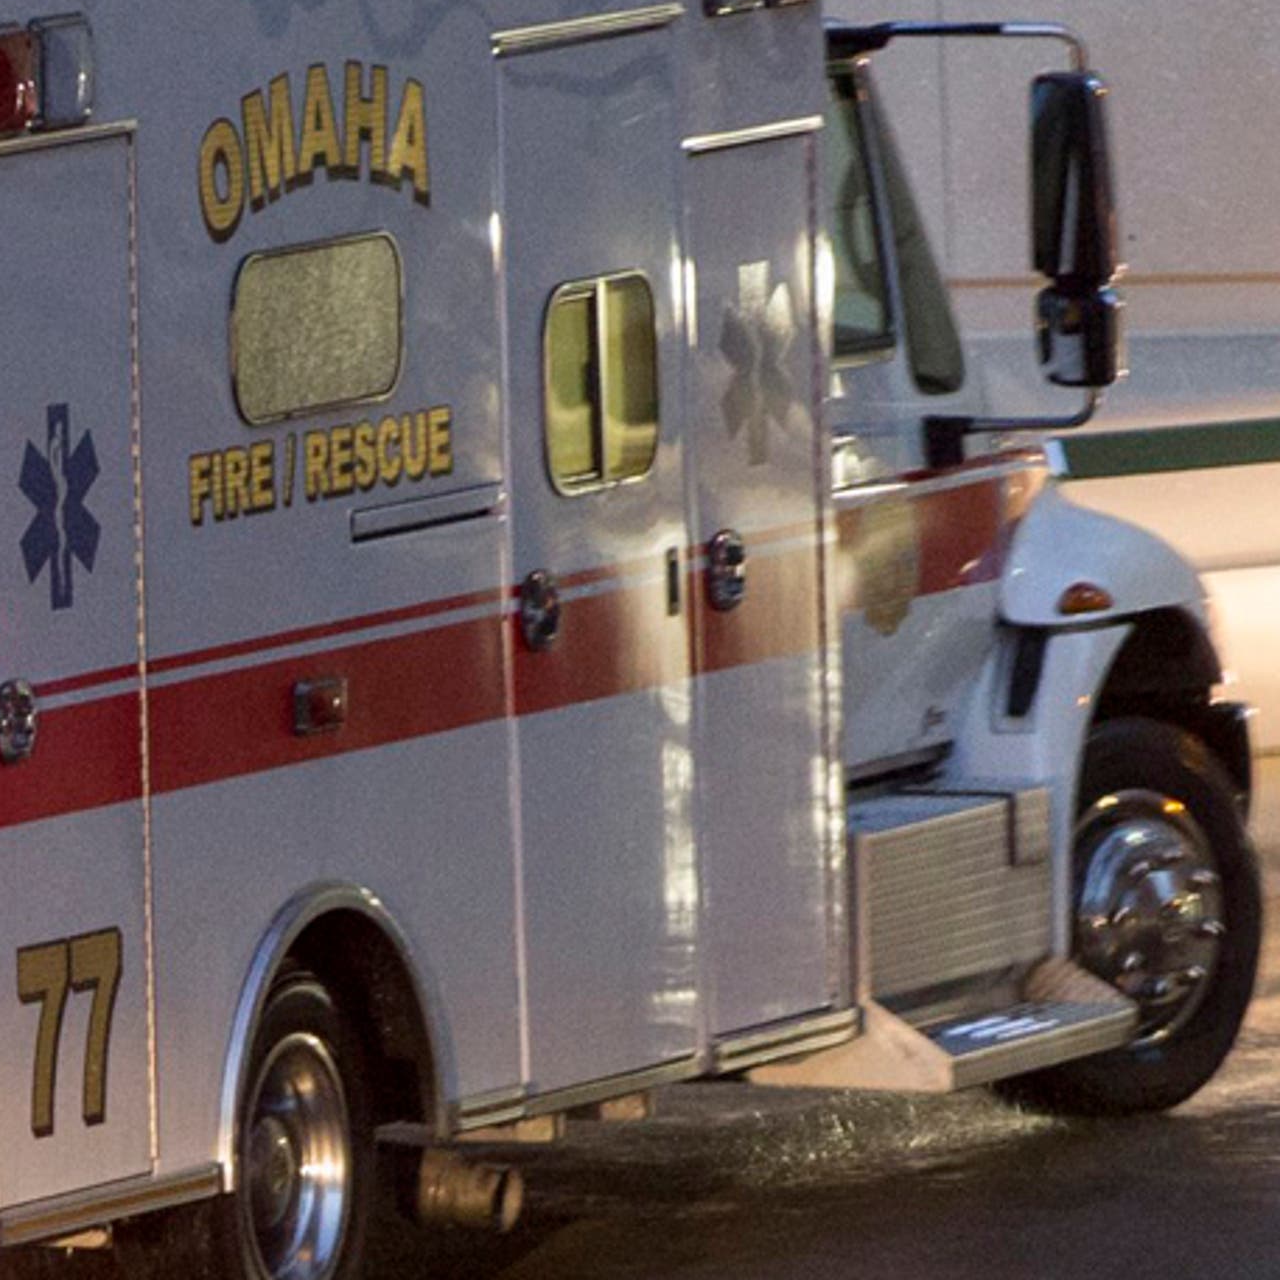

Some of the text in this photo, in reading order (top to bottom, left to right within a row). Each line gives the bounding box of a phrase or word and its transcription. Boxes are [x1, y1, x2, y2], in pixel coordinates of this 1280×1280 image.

[197, 60, 431, 243] OMAHA
[188, 407, 453, 526] FIRE / RESCUE
[17, 926, 122, 1138] 77
